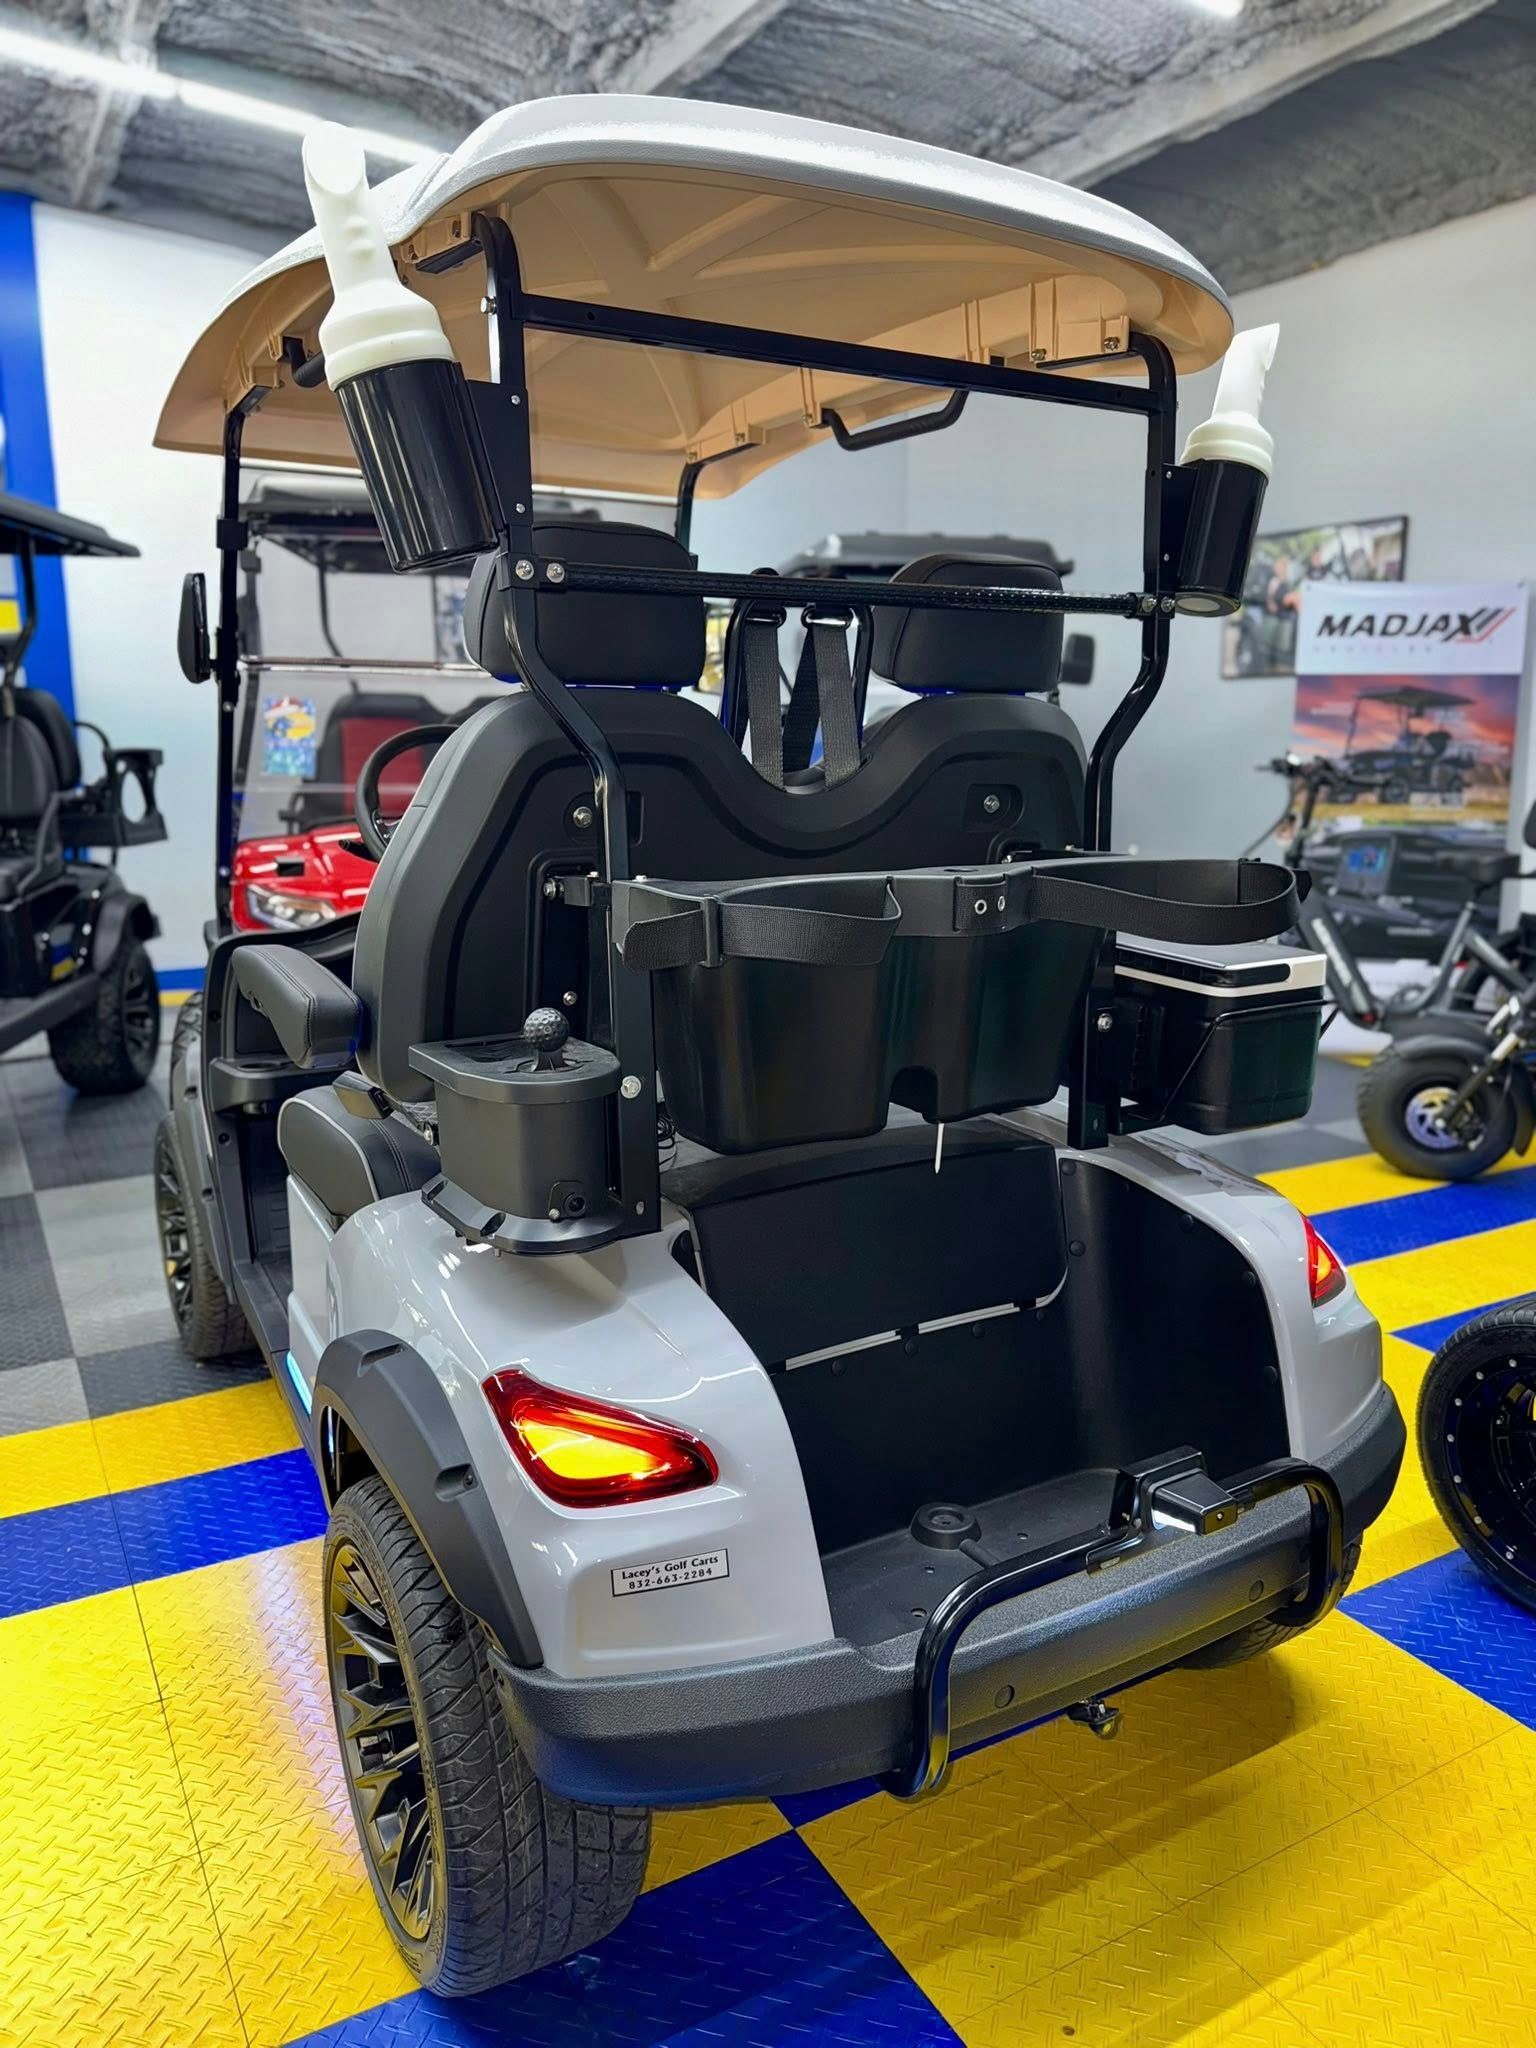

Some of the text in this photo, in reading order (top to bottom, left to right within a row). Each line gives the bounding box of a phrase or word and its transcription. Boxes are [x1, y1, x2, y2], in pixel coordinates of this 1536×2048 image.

[1317, 607, 1489, 642] MADJAX
[622, 1555, 719, 1580] Lacey's Golf Carts
[629, 1567, 713, 1590] 832-663-2284
